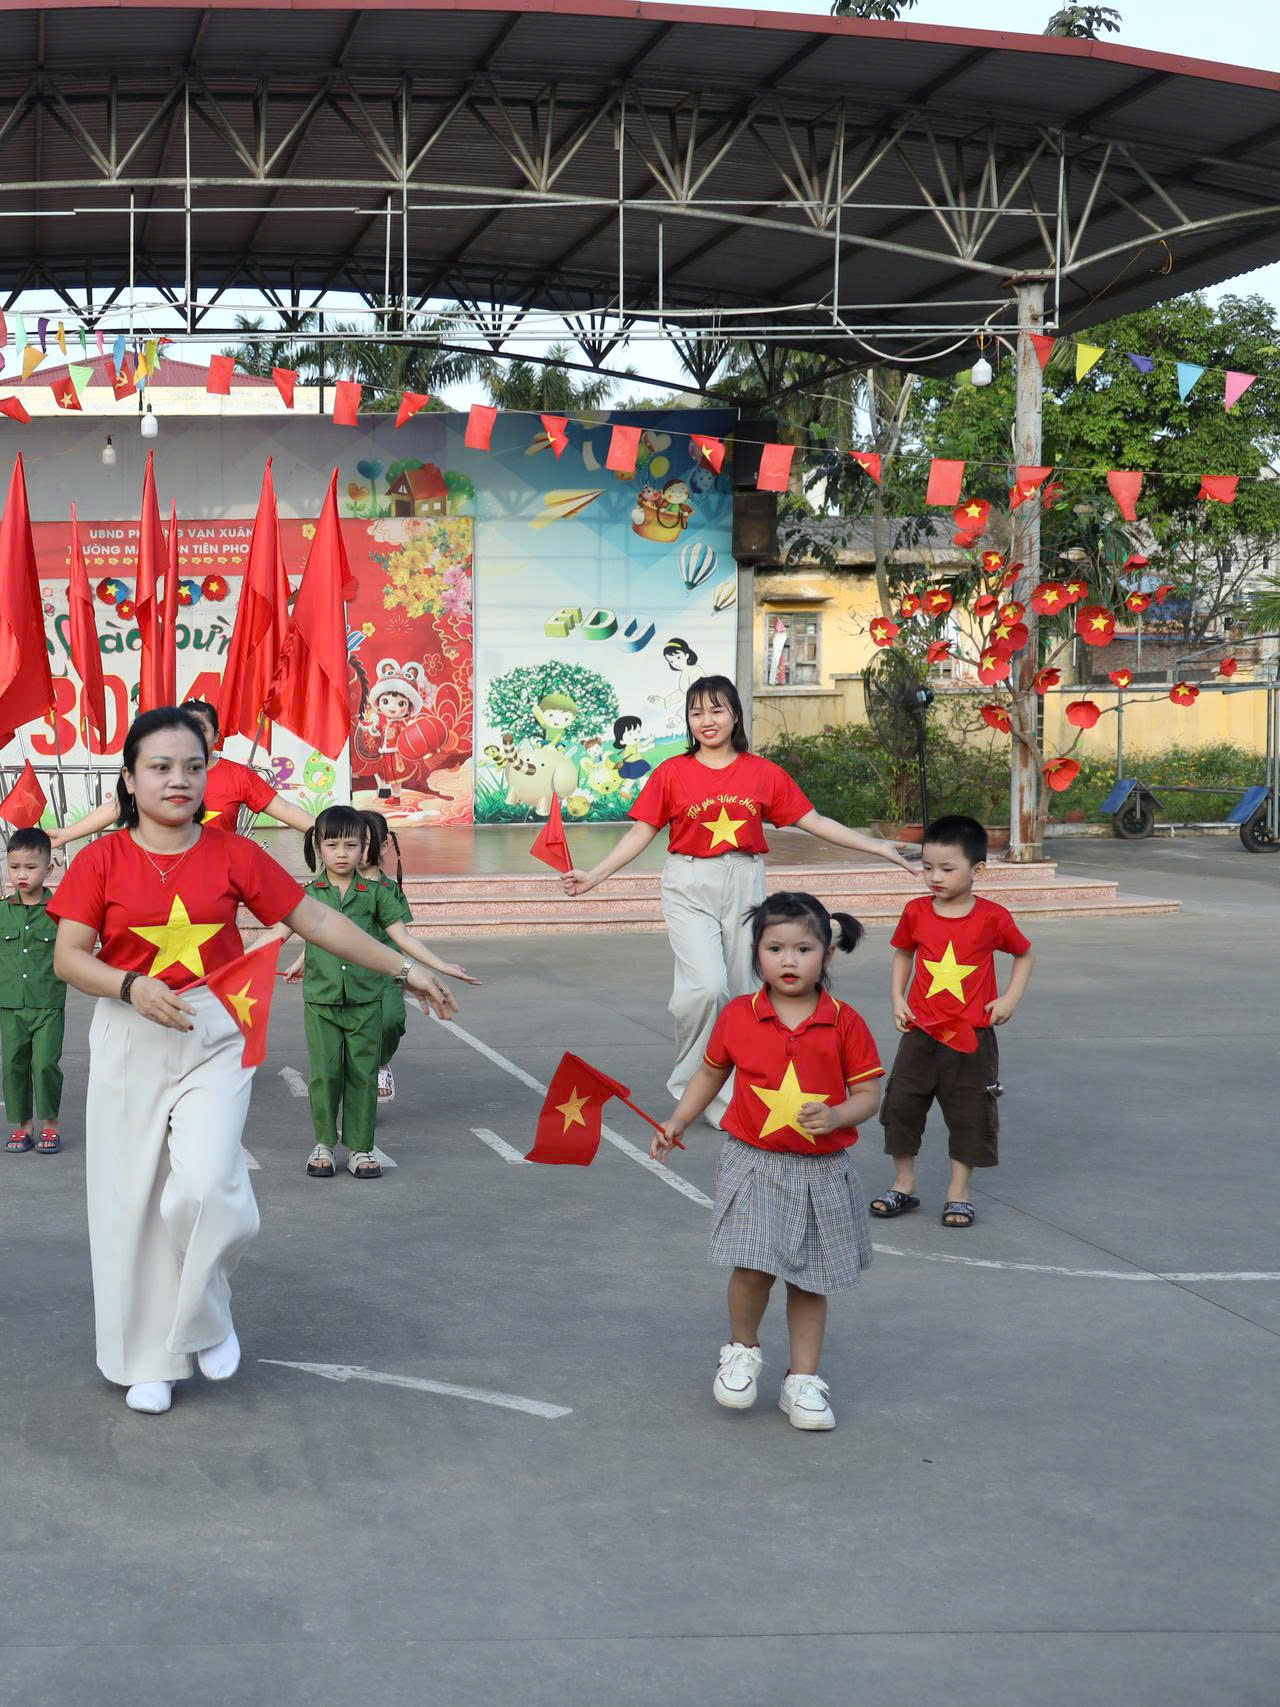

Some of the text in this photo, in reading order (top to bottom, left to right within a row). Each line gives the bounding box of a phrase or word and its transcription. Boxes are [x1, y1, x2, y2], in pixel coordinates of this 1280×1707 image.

[89, 529, 125, 539] UBND
[187, 528, 215, 541] VẠN
[67, 543, 120, 554] TƯỜNG
[193, 542, 219, 554] TIÊN
[222, 544, 250, 553] PHO
[544, 607, 656, 653] EDU
[738, 797, 757, 816] Nam
